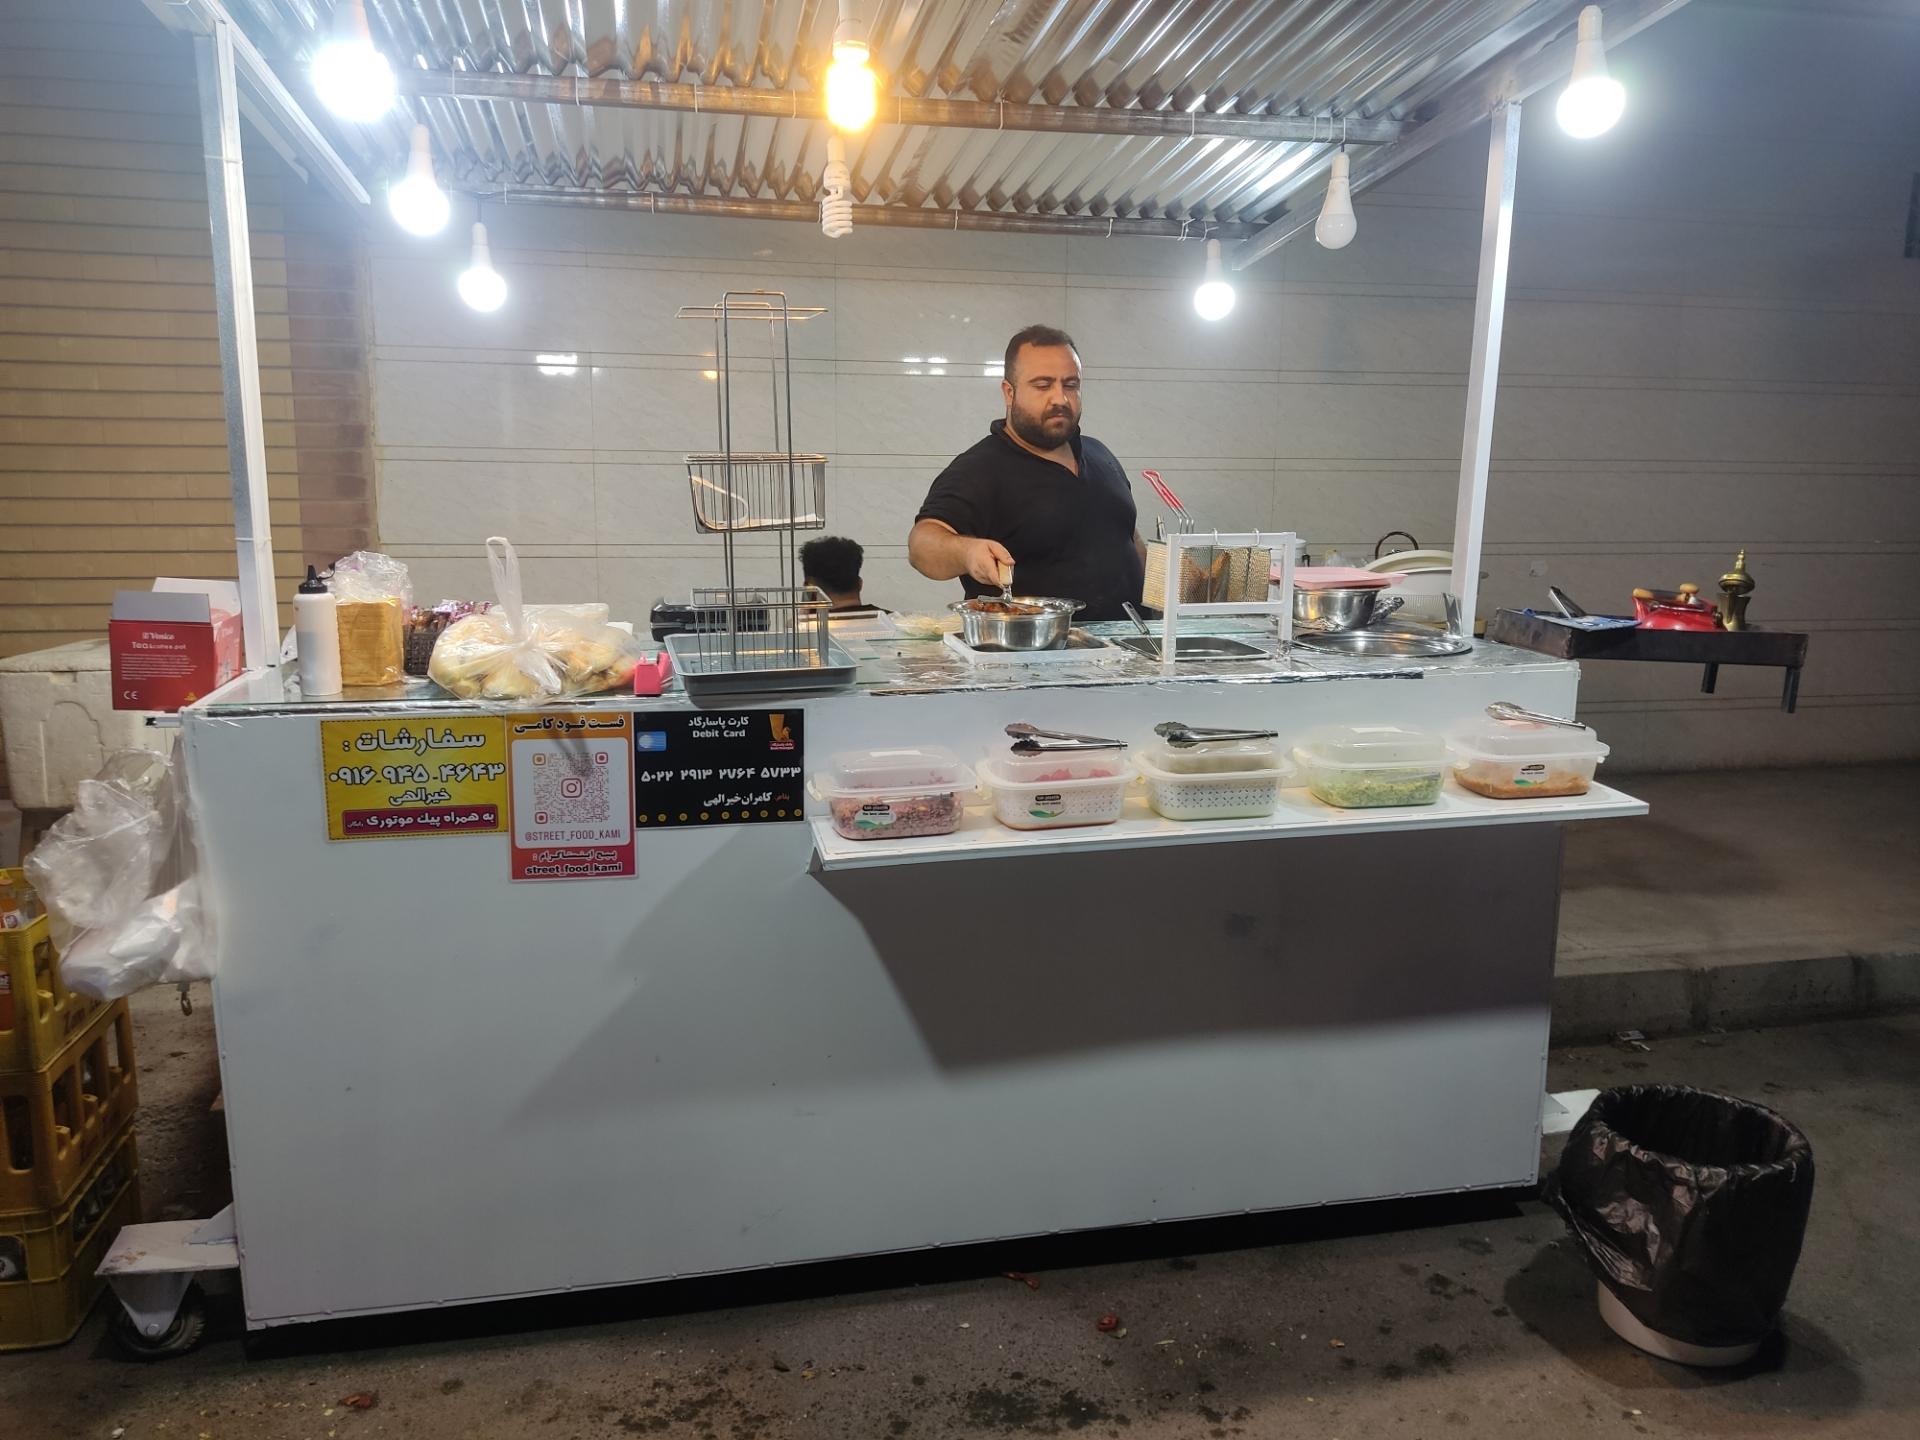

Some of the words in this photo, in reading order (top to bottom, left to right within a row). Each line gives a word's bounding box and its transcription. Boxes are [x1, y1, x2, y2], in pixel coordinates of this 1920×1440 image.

[514, 717, 554, 734] کامی
[556, 716, 586, 732] فود
[588, 714, 625, 730] فست
[688, 717, 726, 729] پاسارگاد
[728, 716, 750, 728] کارت
[692, 729, 720, 738] Debit
[723, 729, 746, 738] Card
[356, 728, 486, 756] سفارشات
[641, 770, 674, 783] ۵۰۲۲
[680, 768, 713, 781] ۲۹۱۳
[719, 767, 756, 780] ۲۷۶۴
[760, 766, 802, 779] ۵۷۳۳
[389, 787, 451, 806] خیرالهی
[366, 815, 414, 829] موتوری
[444, 811, 479, 825] همراه
[482, 812, 495, 823] به
[525, 829, 621, 841] @STREET_FOOD_KAMI
[539, 849, 594, 862] اینستاگرام
[595, 849, 617, 860] پیج
[526, 862, 622, 875] street_food_kami
